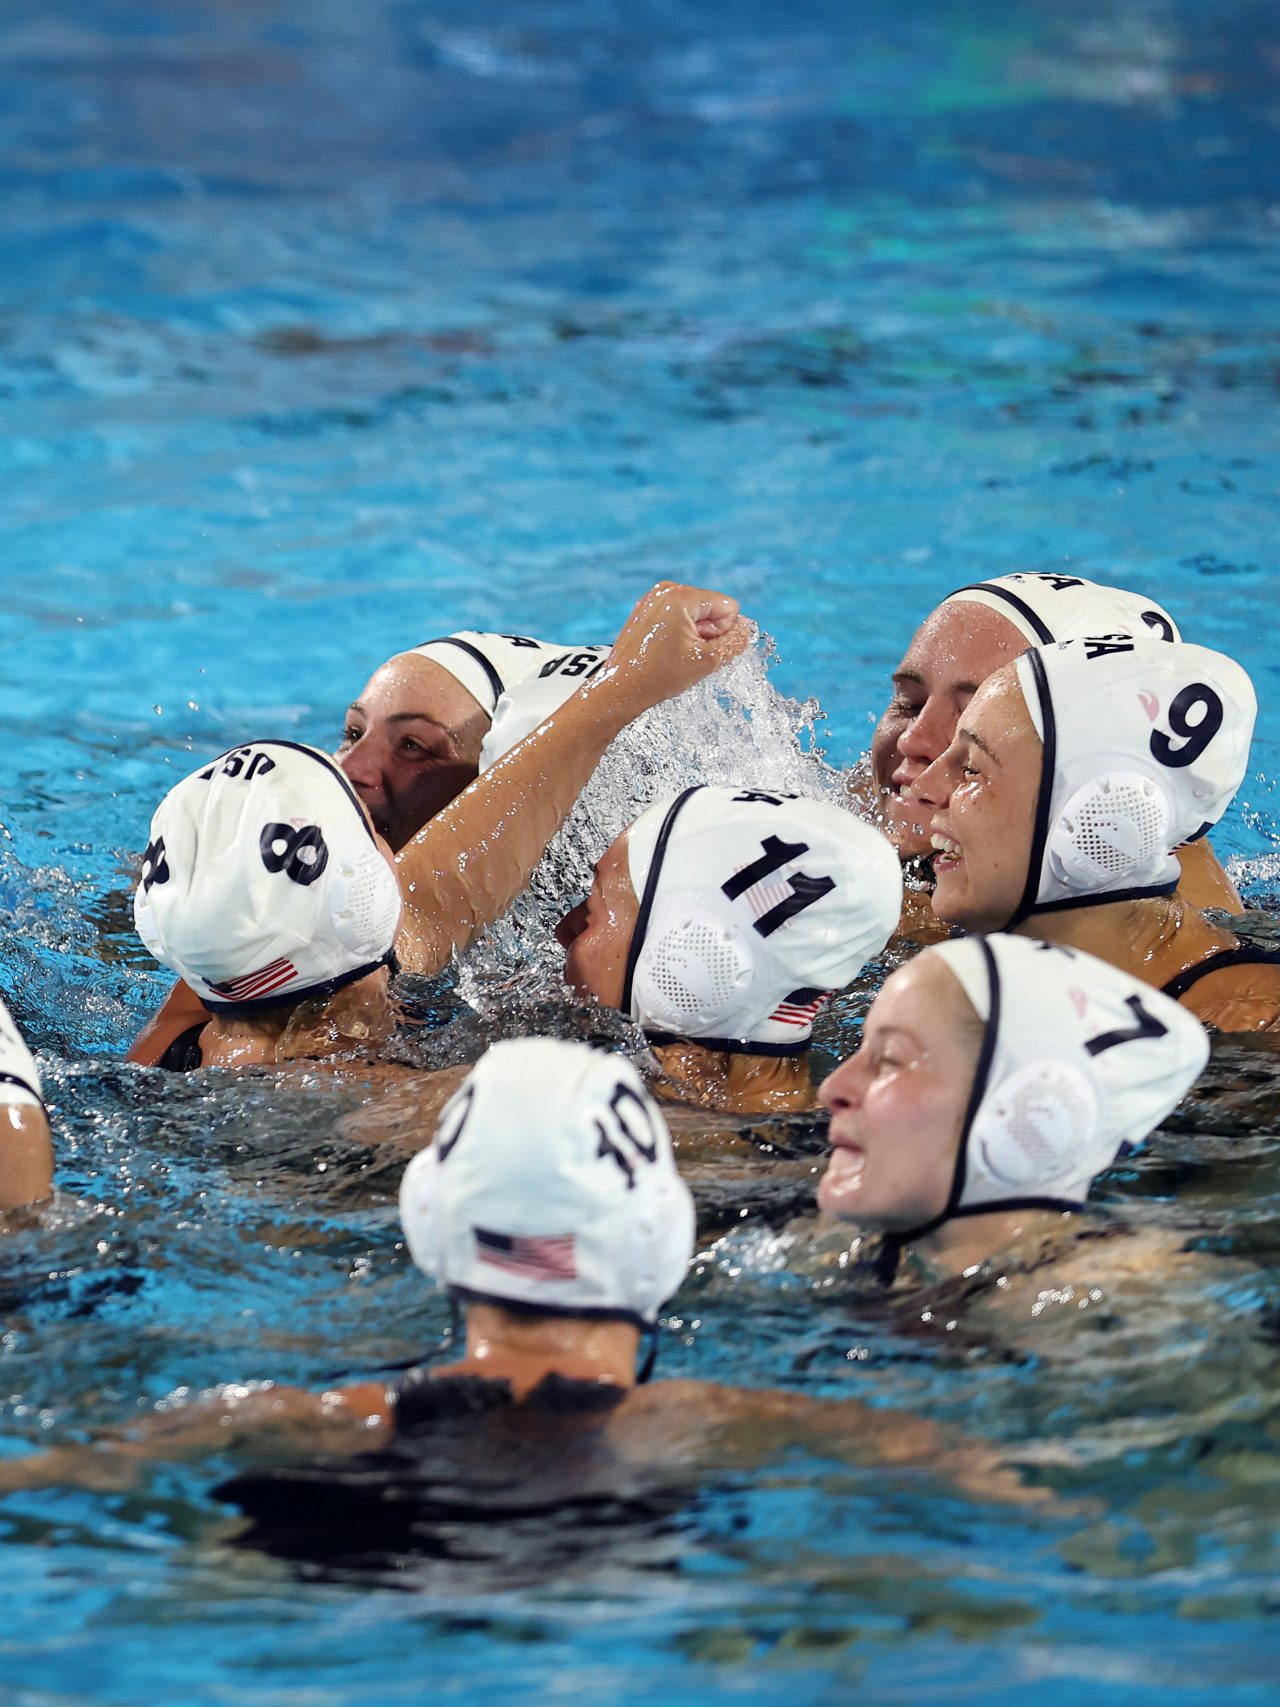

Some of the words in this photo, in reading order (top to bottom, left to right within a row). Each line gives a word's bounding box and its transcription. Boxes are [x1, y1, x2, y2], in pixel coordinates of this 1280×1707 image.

[1150, 682, 1224, 768] 9
[259, 822, 329, 886] 8
[721, 834, 837, 938] 11
[1083, 994, 1168, 1056] 7
[594, 1081, 657, 1189] 10
